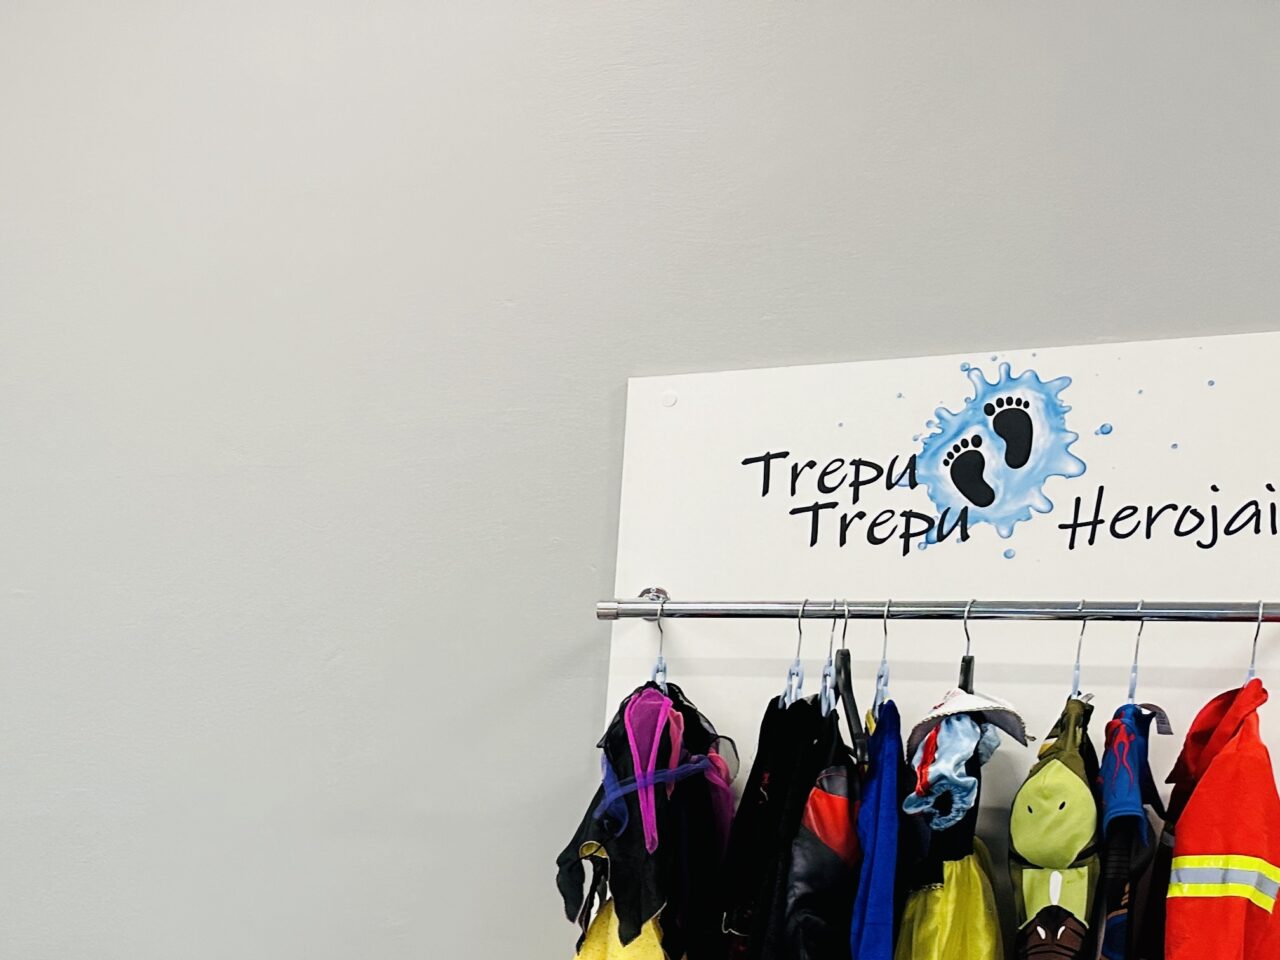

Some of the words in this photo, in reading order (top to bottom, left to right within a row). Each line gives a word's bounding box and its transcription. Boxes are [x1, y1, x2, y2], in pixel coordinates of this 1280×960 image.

[741, 451, 919, 505] Trepu
[789, 501, 970, 557] Trepu
[1058, 483, 1278, 550] Herojai
